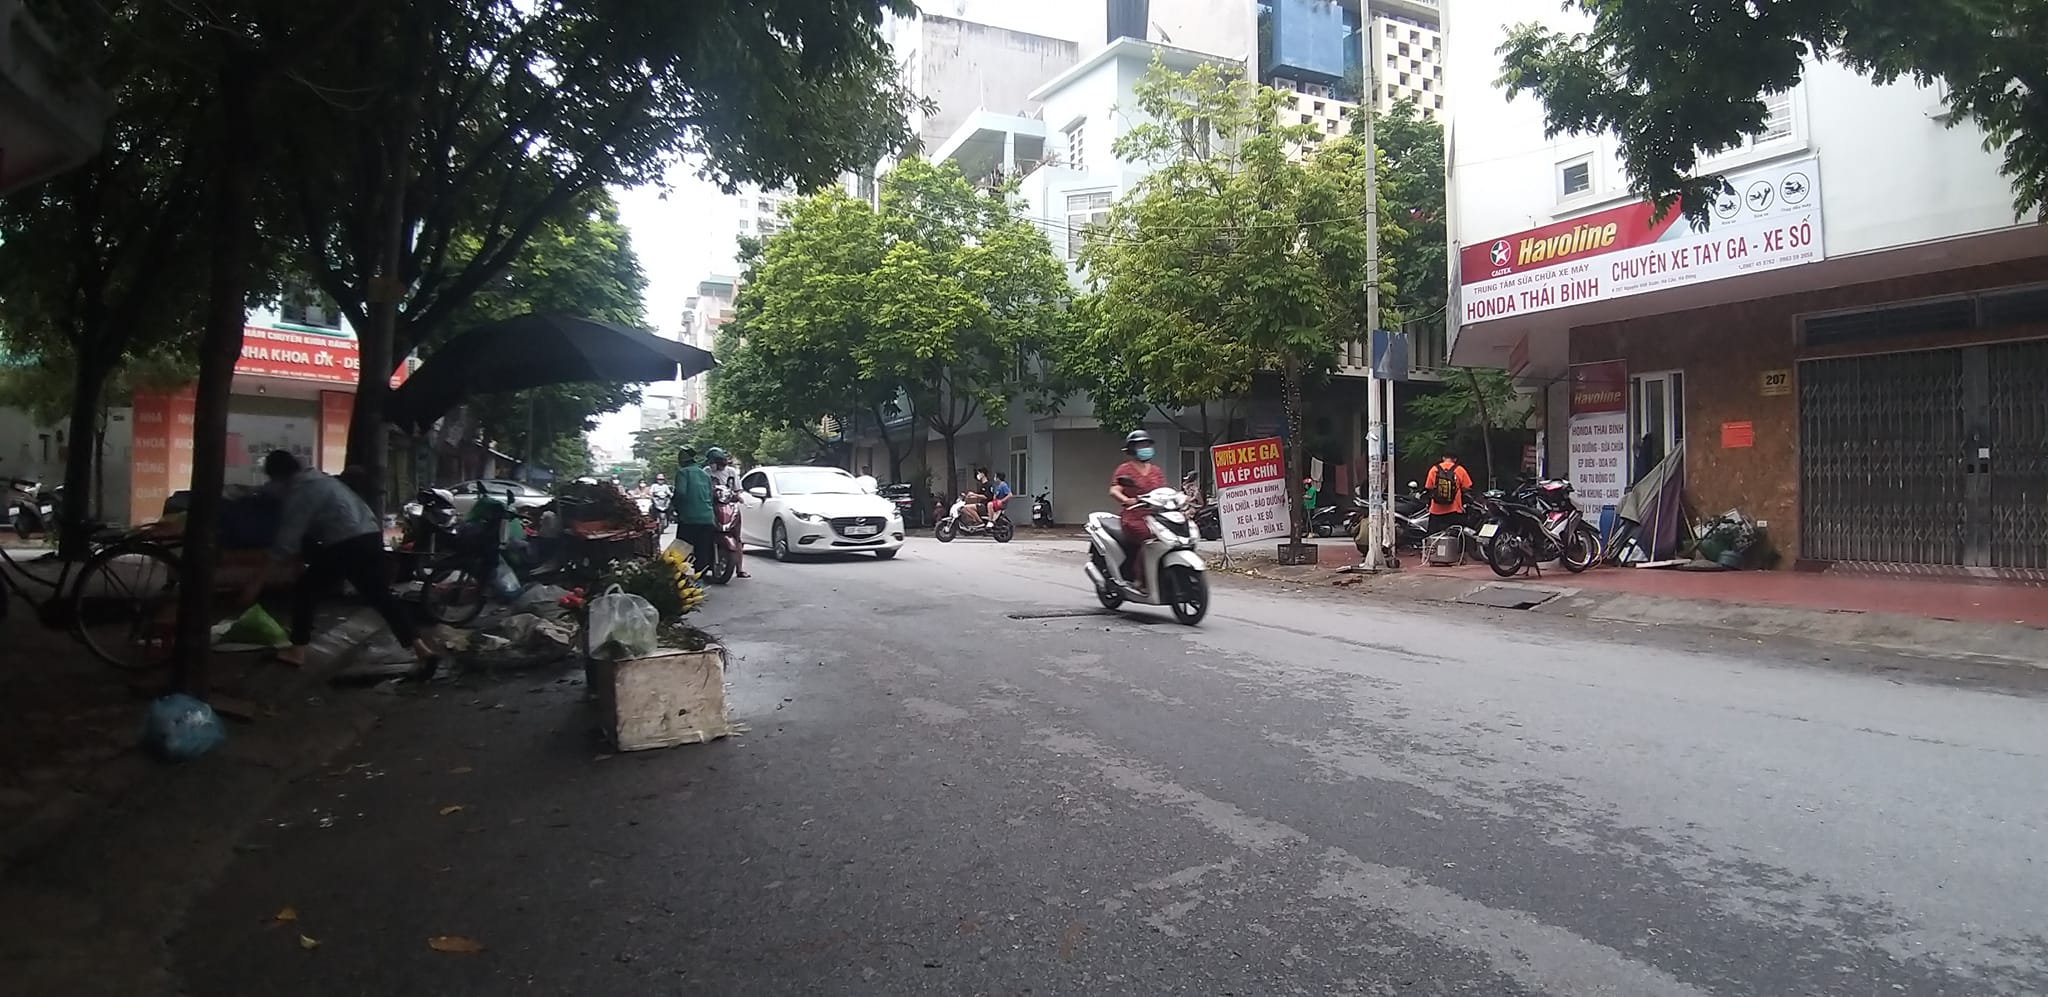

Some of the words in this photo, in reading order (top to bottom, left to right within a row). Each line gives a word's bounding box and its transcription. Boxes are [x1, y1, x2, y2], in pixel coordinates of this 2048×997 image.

[1517, 222, 1618, 266] Havoline
[1611, 250, 1667, 282] CHUYÊN
[1671, 248, 1689, 274] XE
[1693, 241, 1722, 266] TAY
[1727, 236, 1748, 260] GA
[1764, 228, 1784, 253] XE
[1789, 214, 1812, 248] SỐ
[1473, 283, 1498, 295] TRUNG
[1499, 278, 1516, 290] TÂM
[1535, 269, 1557, 282] CHỮA
[1558, 267, 1569, 277] XE
[1571, 262, 1590, 274] MÁY
[1491, 266, 1512, 278] CALTEX
[1467, 294, 1516, 320] HONDA
[1520, 282, 1555, 310] THÁI
[1560, 277, 1599, 303] BÌNH
[271, 348, 310, 365] KHOA
[1766, 374, 1786, 386] 207
[1574, 389, 1622, 406] Havoline
[1571, 426, 1592, 436] HONDA
[1215, 448, 1237, 468] CHUYÊN
[1238, 448, 1257, 465] XE
[1259, 443, 1280, 460] GA
[1221, 466, 1236, 484] VÁ
[1238, 465, 1251, 482] ÉP
[1253, 463, 1278, 479] CHÍN
[1226, 489, 1248, 500] HONDA
[1222, 502, 1234, 514] SỬA
[1235, 500, 1249, 512] CHỮA
[1237, 515, 1245, 525] XE
[1245, 514, 1253, 524] GA
[1257, 513, 1265, 521] XE
[1232, 530, 1247, 540] THAY
[1276, 522, 1284, 531] XE
